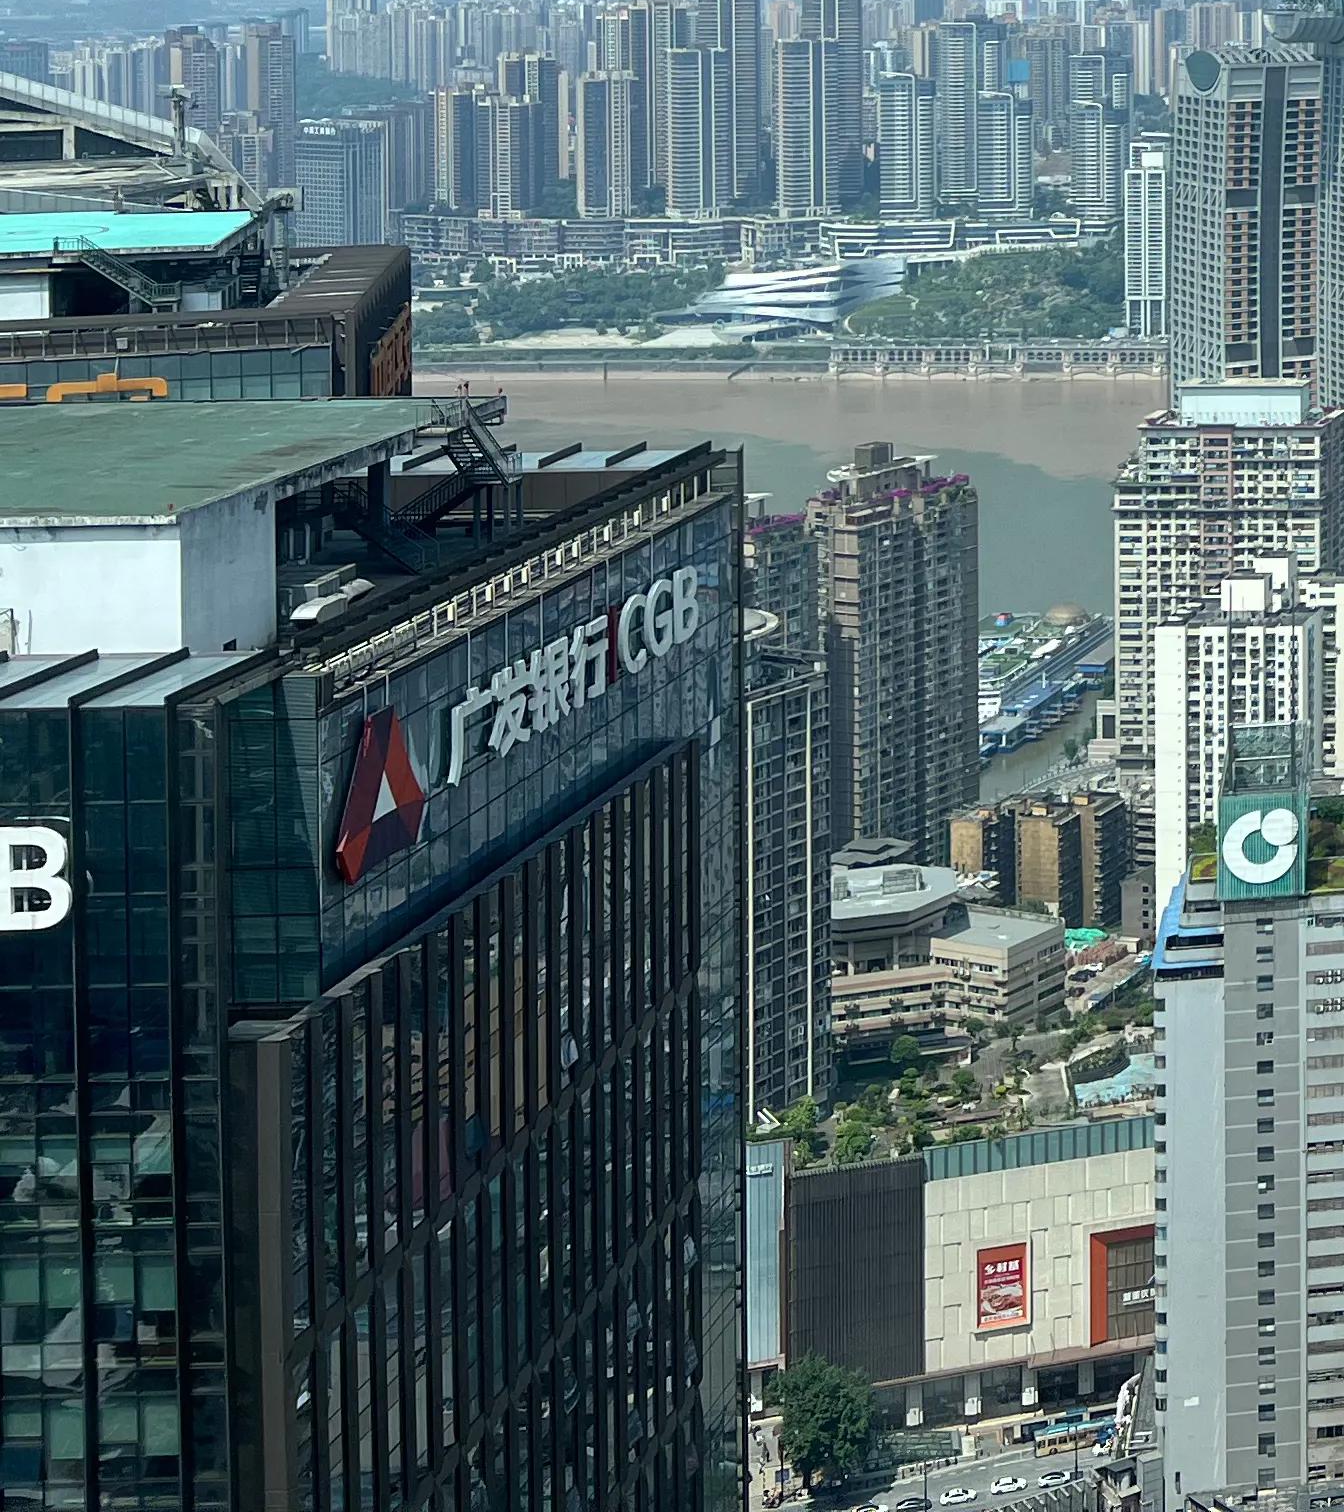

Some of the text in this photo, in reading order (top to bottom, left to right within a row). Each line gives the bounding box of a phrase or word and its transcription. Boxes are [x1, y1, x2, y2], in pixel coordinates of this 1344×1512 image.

[616, 565, 700, 675] CGB
[447, 614, 609, 786] 广发银行
